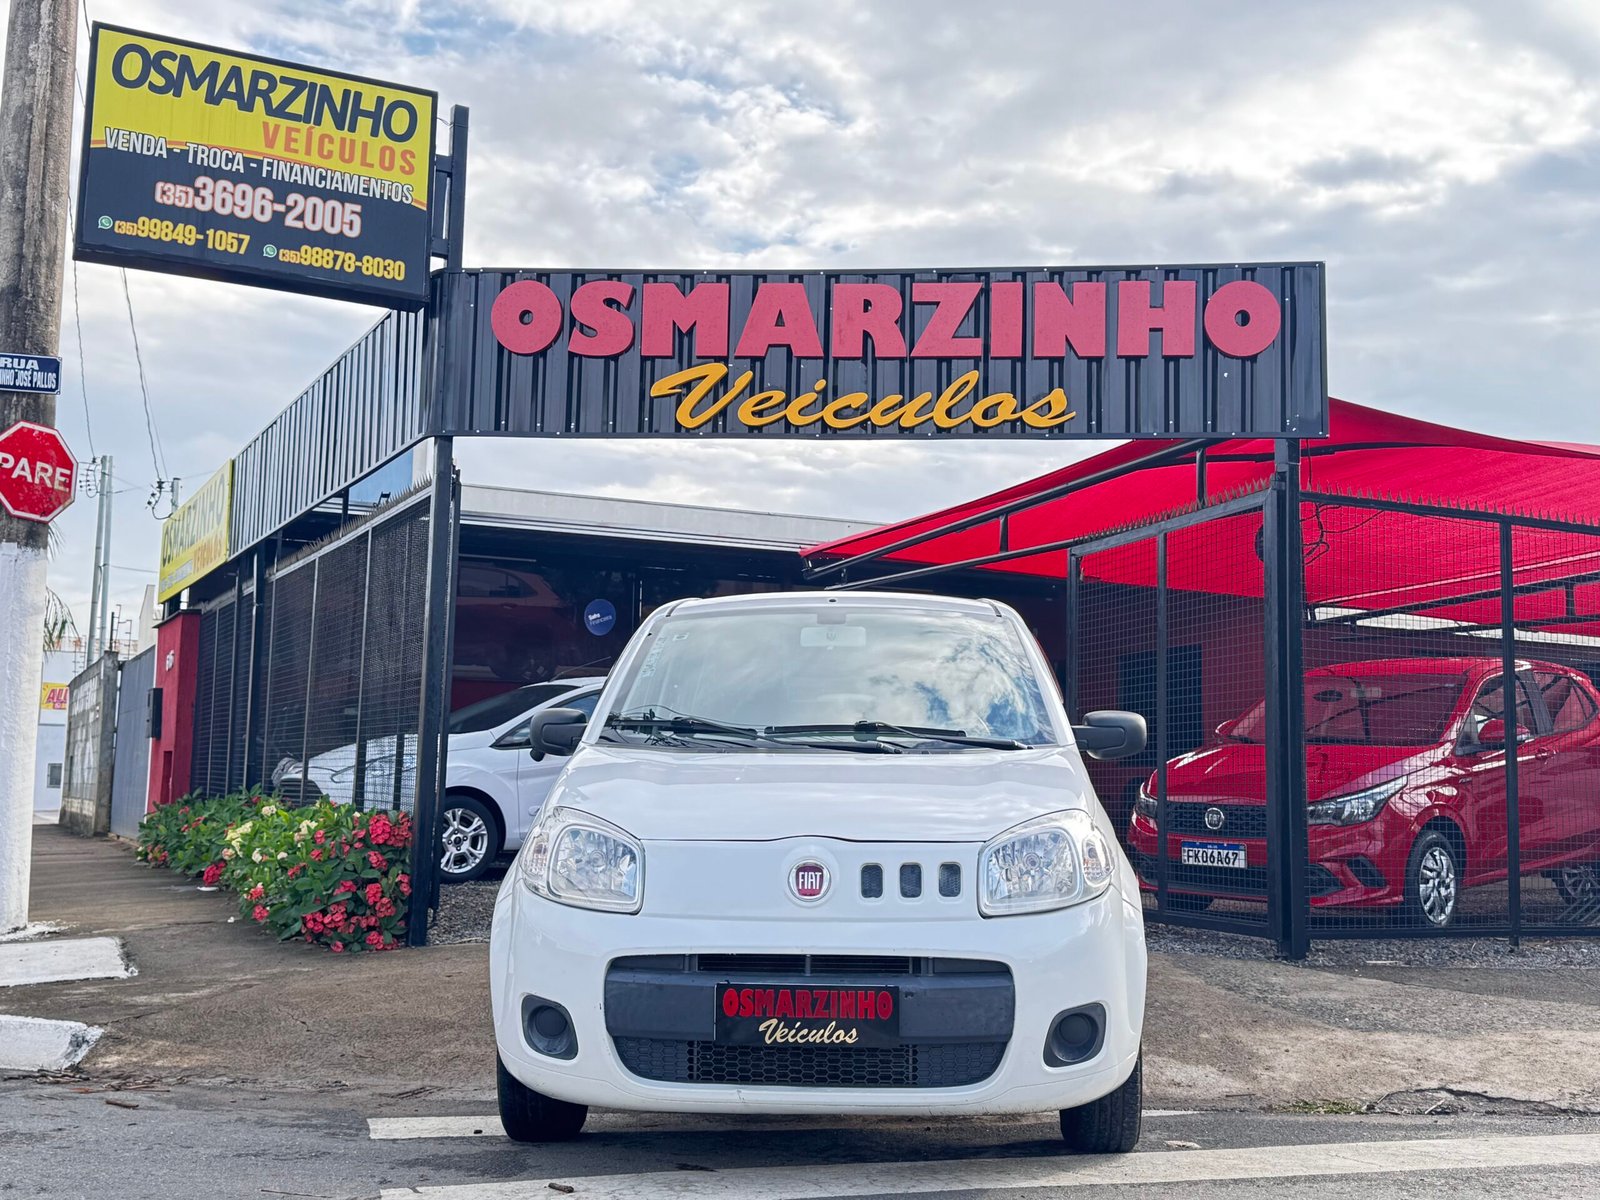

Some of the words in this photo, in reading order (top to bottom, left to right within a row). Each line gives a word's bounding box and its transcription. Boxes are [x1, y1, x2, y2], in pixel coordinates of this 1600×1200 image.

[112, 43, 418, 142] OSMARZINHO
[104, 126, 168, 159] VENDA
[186, 142, 245, 173] TROCA
[261, 157, 414, 205] FINANCIAMENTOS
[262, 121, 416, 176] VEÍCULOS
[490, 278, 1282, 359] OSMARZINHO
[0, 356, 39, 370] RUA
[0, 451, 71, 493] PARE
[799, 871, 822, 890] FIAT
[722, 988, 893, 1020] OSMARZINHO
